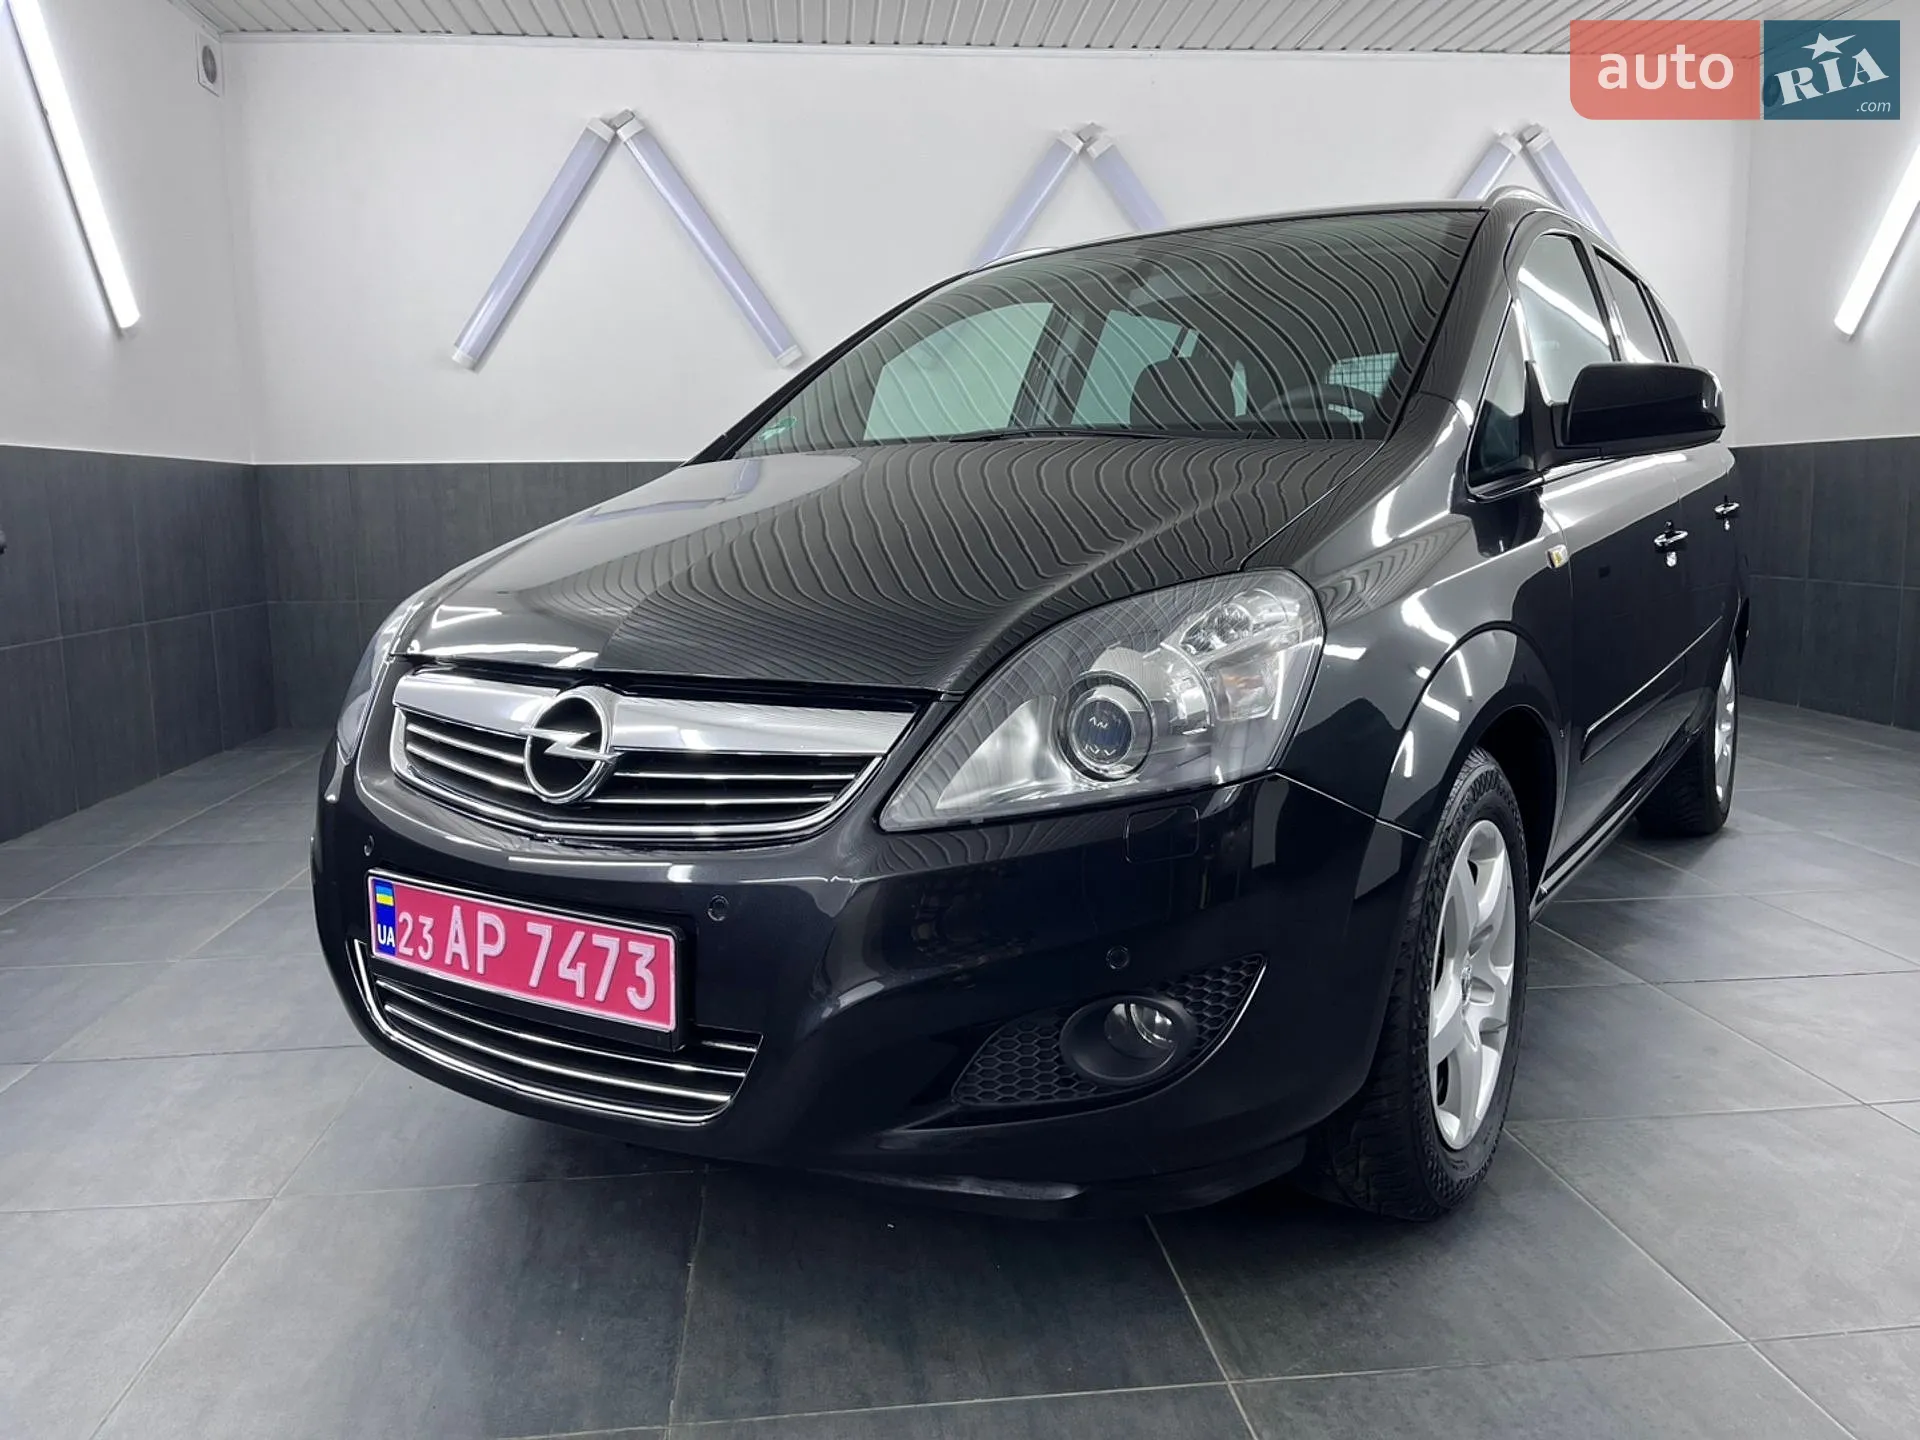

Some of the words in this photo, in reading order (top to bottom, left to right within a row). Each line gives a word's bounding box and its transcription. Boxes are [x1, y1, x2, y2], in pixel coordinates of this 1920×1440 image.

[377, 923, 395, 947] UA
[399, 912, 434, 961] 23
[444, 905, 506, 975] AP
[527, 921, 656, 1010] 7473
